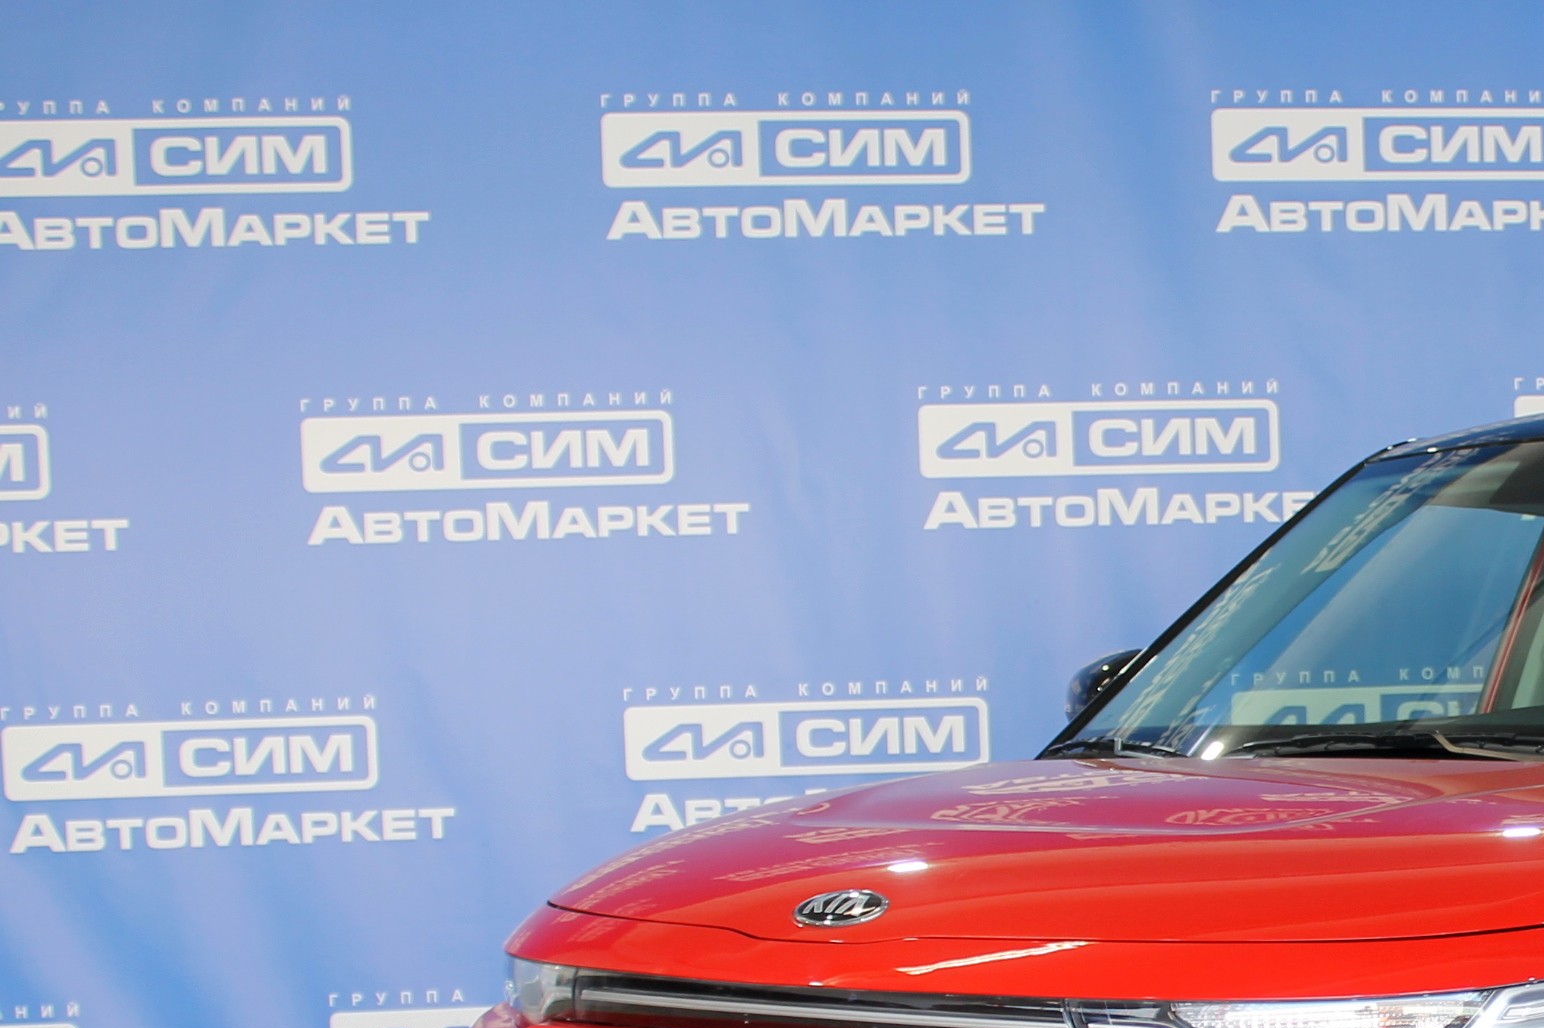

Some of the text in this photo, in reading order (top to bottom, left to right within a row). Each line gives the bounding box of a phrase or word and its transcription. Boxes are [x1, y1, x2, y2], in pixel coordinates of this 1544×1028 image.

[152, 95, 352, 113] КОМПАНИЙ
[600, 90, 971, 107] ГРУППА КОМПАНИЙ
[1210, 90, 1343, 103] ГРУППА
[150, 136, 328, 176] СИМ
[774, 128, 947, 168] СИМ
[1379, 125, 1543, 163] СИМ
[301, 390, 674, 411] ГРУППА КОМПАНИЙ
[917, 379, 1279, 400] ГРУППА КОМПАНИЙ
[1088, 418, 1256, 456] СИМ
[477, 430, 650, 470] СИМ
[623, 676, 989, 701] ГРУППА КОМПАНИЙ
[0, 694, 377, 720] ГРУППА КОМПАНИЙ
[796, 714, 966, 759] СИМ
[179, 734, 353, 778] СИМ
[802, 892, 877, 917] KIA
[328, 990, 464, 1007] ГРУППА
